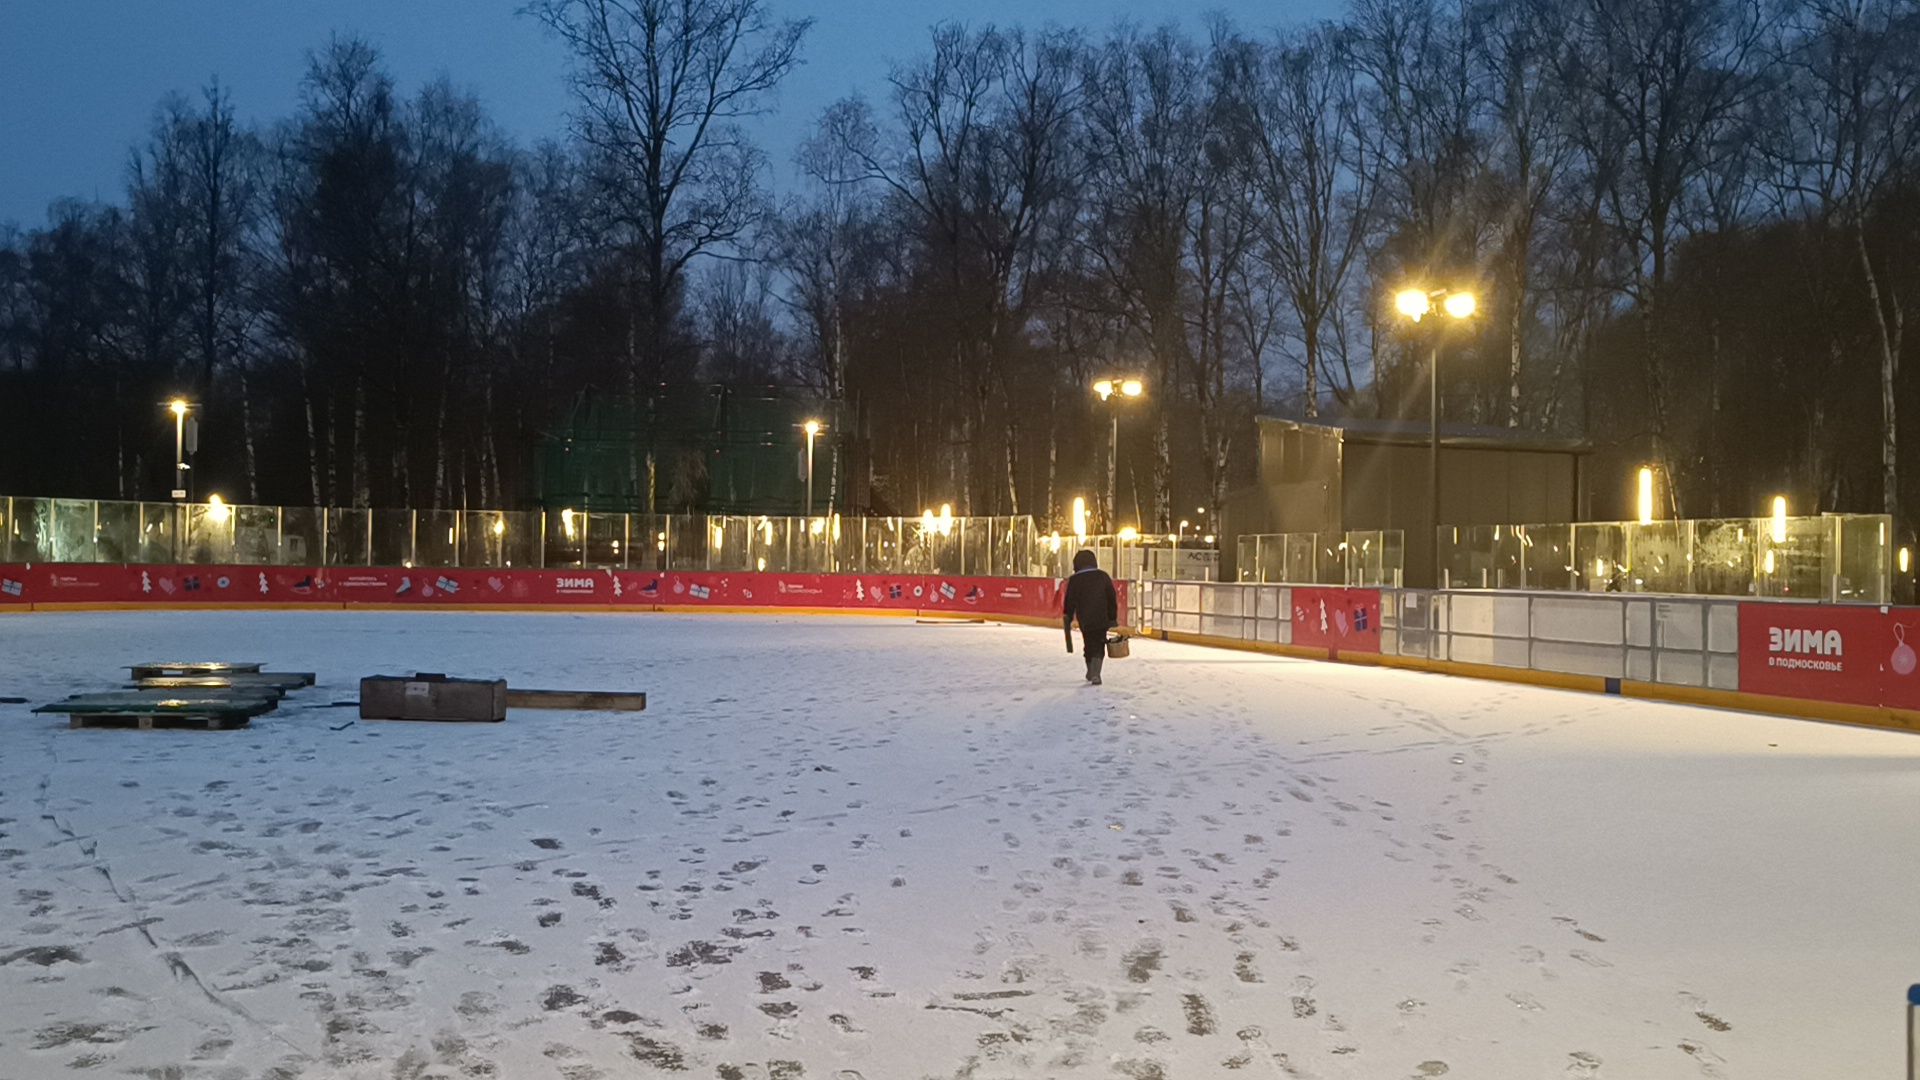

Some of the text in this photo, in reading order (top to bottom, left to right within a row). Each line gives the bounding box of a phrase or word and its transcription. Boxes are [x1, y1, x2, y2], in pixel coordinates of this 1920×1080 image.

[556, 577, 594, 588] ЗИМА
[1768, 626, 1843, 656] ЗИМА
[1776, 657, 1843, 672] ПОДМОСКОВЬЕ
